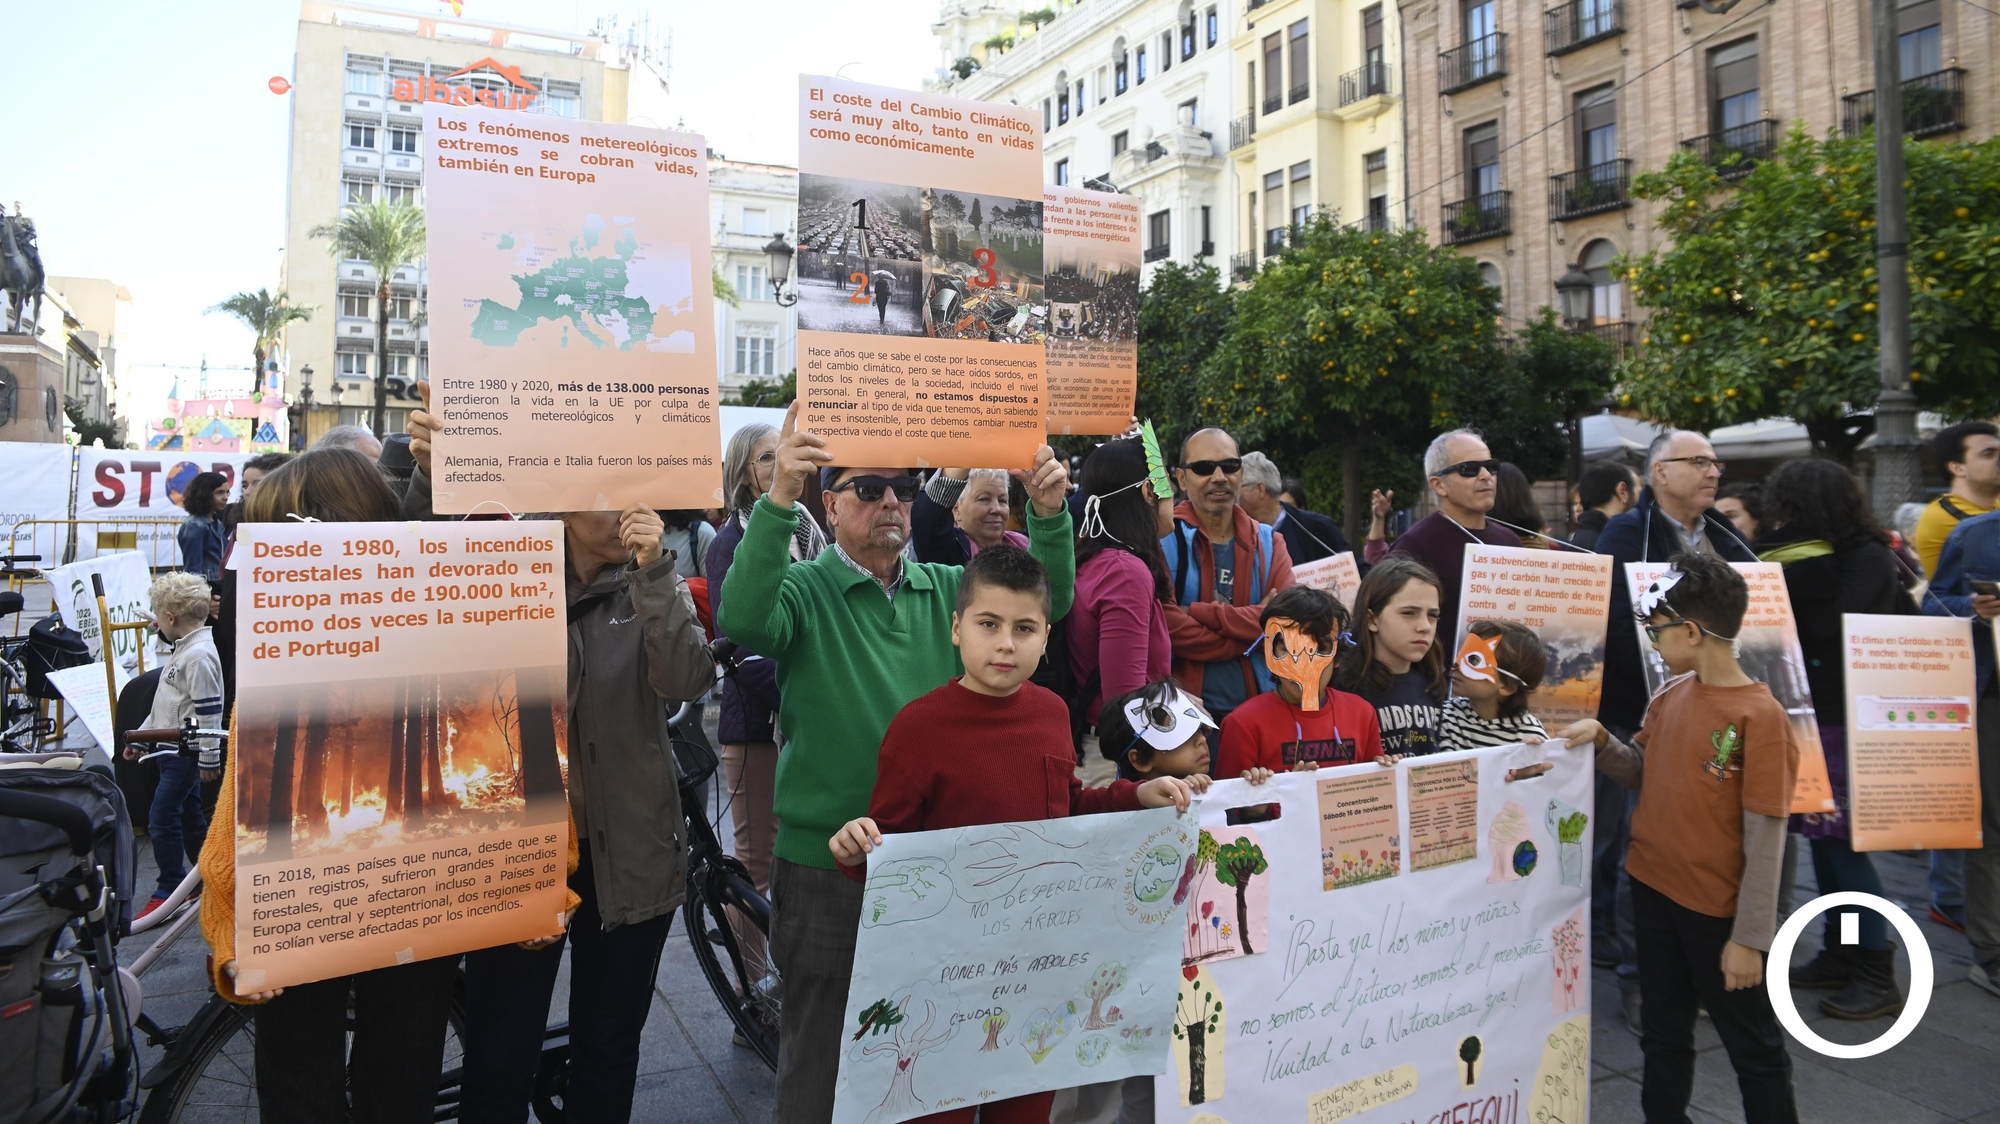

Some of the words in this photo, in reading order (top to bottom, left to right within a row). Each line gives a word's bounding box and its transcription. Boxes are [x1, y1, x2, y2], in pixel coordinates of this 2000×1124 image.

[392, 75, 538, 113] albasur
[810, 88, 823, 101] El
[833, 94, 872, 108] coste
[880, 98, 902, 112] del
[910, 103, 962, 121] Cambio
[970, 112, 1033, 135] Climático,
[438, 117, 467, 132] Los
[478, 121, 570, 144] fenómenos
[581, 136, 698, 158] metereológicos
[810, 108, 842, 122] será
[852, 114, 883, 130] muy
[892, 118, 923, 136] alto,
[932, 124, 969, 140] tanto
[977, 133, 993, 143] en
[1001, 135, 1034, 150] vidas
[810, 128, 851, 142] como
[855, 129, 974, 159] económicamente
[438, 138, 519, 156] extremos
[541, 150, 558, 161] se
[580, 153, 634, 168] cobran
[655, 160, 698, 178] vidas,
[438, 155, 509, 174] también
[514, 166, 534, 177] en
[540, 166, 595, 185] Europa
[1064, 196, 1101, 207] gobiernos
[1108, 201, 1139, 212] valientes
[1076, 207, 1087, 216] las
[1090, 210, 1121, 220] personas
[852, 198, 870, 230] 1
[1050, 215, 1074, 225] frente
[1096, 220, 1127, 232] intereses
[1053, 228, 1089, 238] empresas
[1090, 232, 1131, 243] energéticas
[973, 248, 998, 288] 3
[849, 272, 870, 304] 2
[808, 347, 831, 357] Hace
[834, 348, 855, 358] años
[858, 351, 875, 361] que
[878, 352, 888, 360] se
[890, 352, 911, 361] sabe
[913, 353, 921, 362] el
[924, 355, 947, 364] coste
[949, 356, 963, 365] por
[966, 356, 978, 365] las
[980, 358, 1037, 368] consecuencias
[443, 379, 475, 389] Entre
[480, 379, 507, 390] 1980
[511, 382, 518, 393] y
[522, 380, 553, 393] 2020,
[558, 381, 583, 392] más
[587, 382, 602, 392] de
[606, 383, 654, 393] 138.000
[658, 386, 709, 396] personas
[808, 400, 858, 409] renunciar
[916, 392, 928, 400] no
[934, 392, 974, 401] estamos
[979, 393, 1028, 404] dispuestos
[254, 540, 322, 558] Desde
[343, 539, 400, 558] 1980,
[420, 538, 448, 554] los
[465, 536, 553, 553] incendios
[253, 564, 362, 583] forestales
[378, 563, 414, 579] han
[429, 560, 518, 578] devorado
[531, 562, 553, 574] en
[1318, 558, 1351, 573] reducirá
[1473, 554, 1488, 563] Las
[1491, 556, 1549, 568] subvenciones
[1551, 561, 1559, 569] al
[1562, 562, 1597, 573] petróleo,
[1314, 574, 1339, 586] futuro
[1471, 570, 1487, 580] gas
[1500, 572, 1508, 580] el
[1511, 573, 1541, 582] carbón
[1544, 574, 1560, 584] han
[1563, 577, 1593, 586] crecido
[1757, 571, 1779, 581] jacta
[254, 592, 331, 611] Europa
[341, 591, 383, 605] mas
[391, 587, 416, 603] de
[424, 583, 503, 601] 190.000
[511, 582, 554, 599] km²,
[1470, 584, 1492, 594] 50%
[1495, 586, 1521, 596] desde
[1535, 589, 1569, 599] Acuerdo
[1572, 592, 1582, 600] de
[1468, 601, 1497, 609] contra
[1508, 602, 1516, 610] el
[1526, 604, 1557, 613] cambio
[1567, 605, 1604, 616] climático
[253, 619, 314, 634] como
[324, 614, 361, 631] dos
[370, 613, 428, 628] veces
[437, 609, 454, 624] la
[463, 604, 555, 626] superficie
[1523, 617, 1545, 627] 2015
[1753, 618, 1786, 627] ciudad?
[253, 642, 281, 659] de
[289, 636, 379, 658] Portugal
[1869, 649, 1898, 657] noches
[1903, 650, 1944, 659] tropicales
[1336, 796, 1379, 808] Concentración
[1323, 812, 1347, 821] Sábado
[1362, 804, 1393, 814] noviembre
[253, 874, 270, 886] En
[278, 867, 315, 883] 2018,
[323, 864, 350, 876] mas
[357, 857, 396, 874] países
[402, 853, 426, 867] que
[432, 847, 472, 860] nunca,
[478, 839, 512, 854] desde
[518, 837, 539, 850] que
[544, 834, 557, 844] se
[969, 902, 989, 919] NO
[982, 918, 1011, 937] LOS
[940, 963, 985, 984] PONER
[992, 955, 1018, 977] MÁS
[1027, 952, 1090, 973] ARBOLES
[992, 983, 1011, 1000] EN
[1014, 983, 1027, 995] LA
[949, 1006, 1003, 1026] CIUDAD
